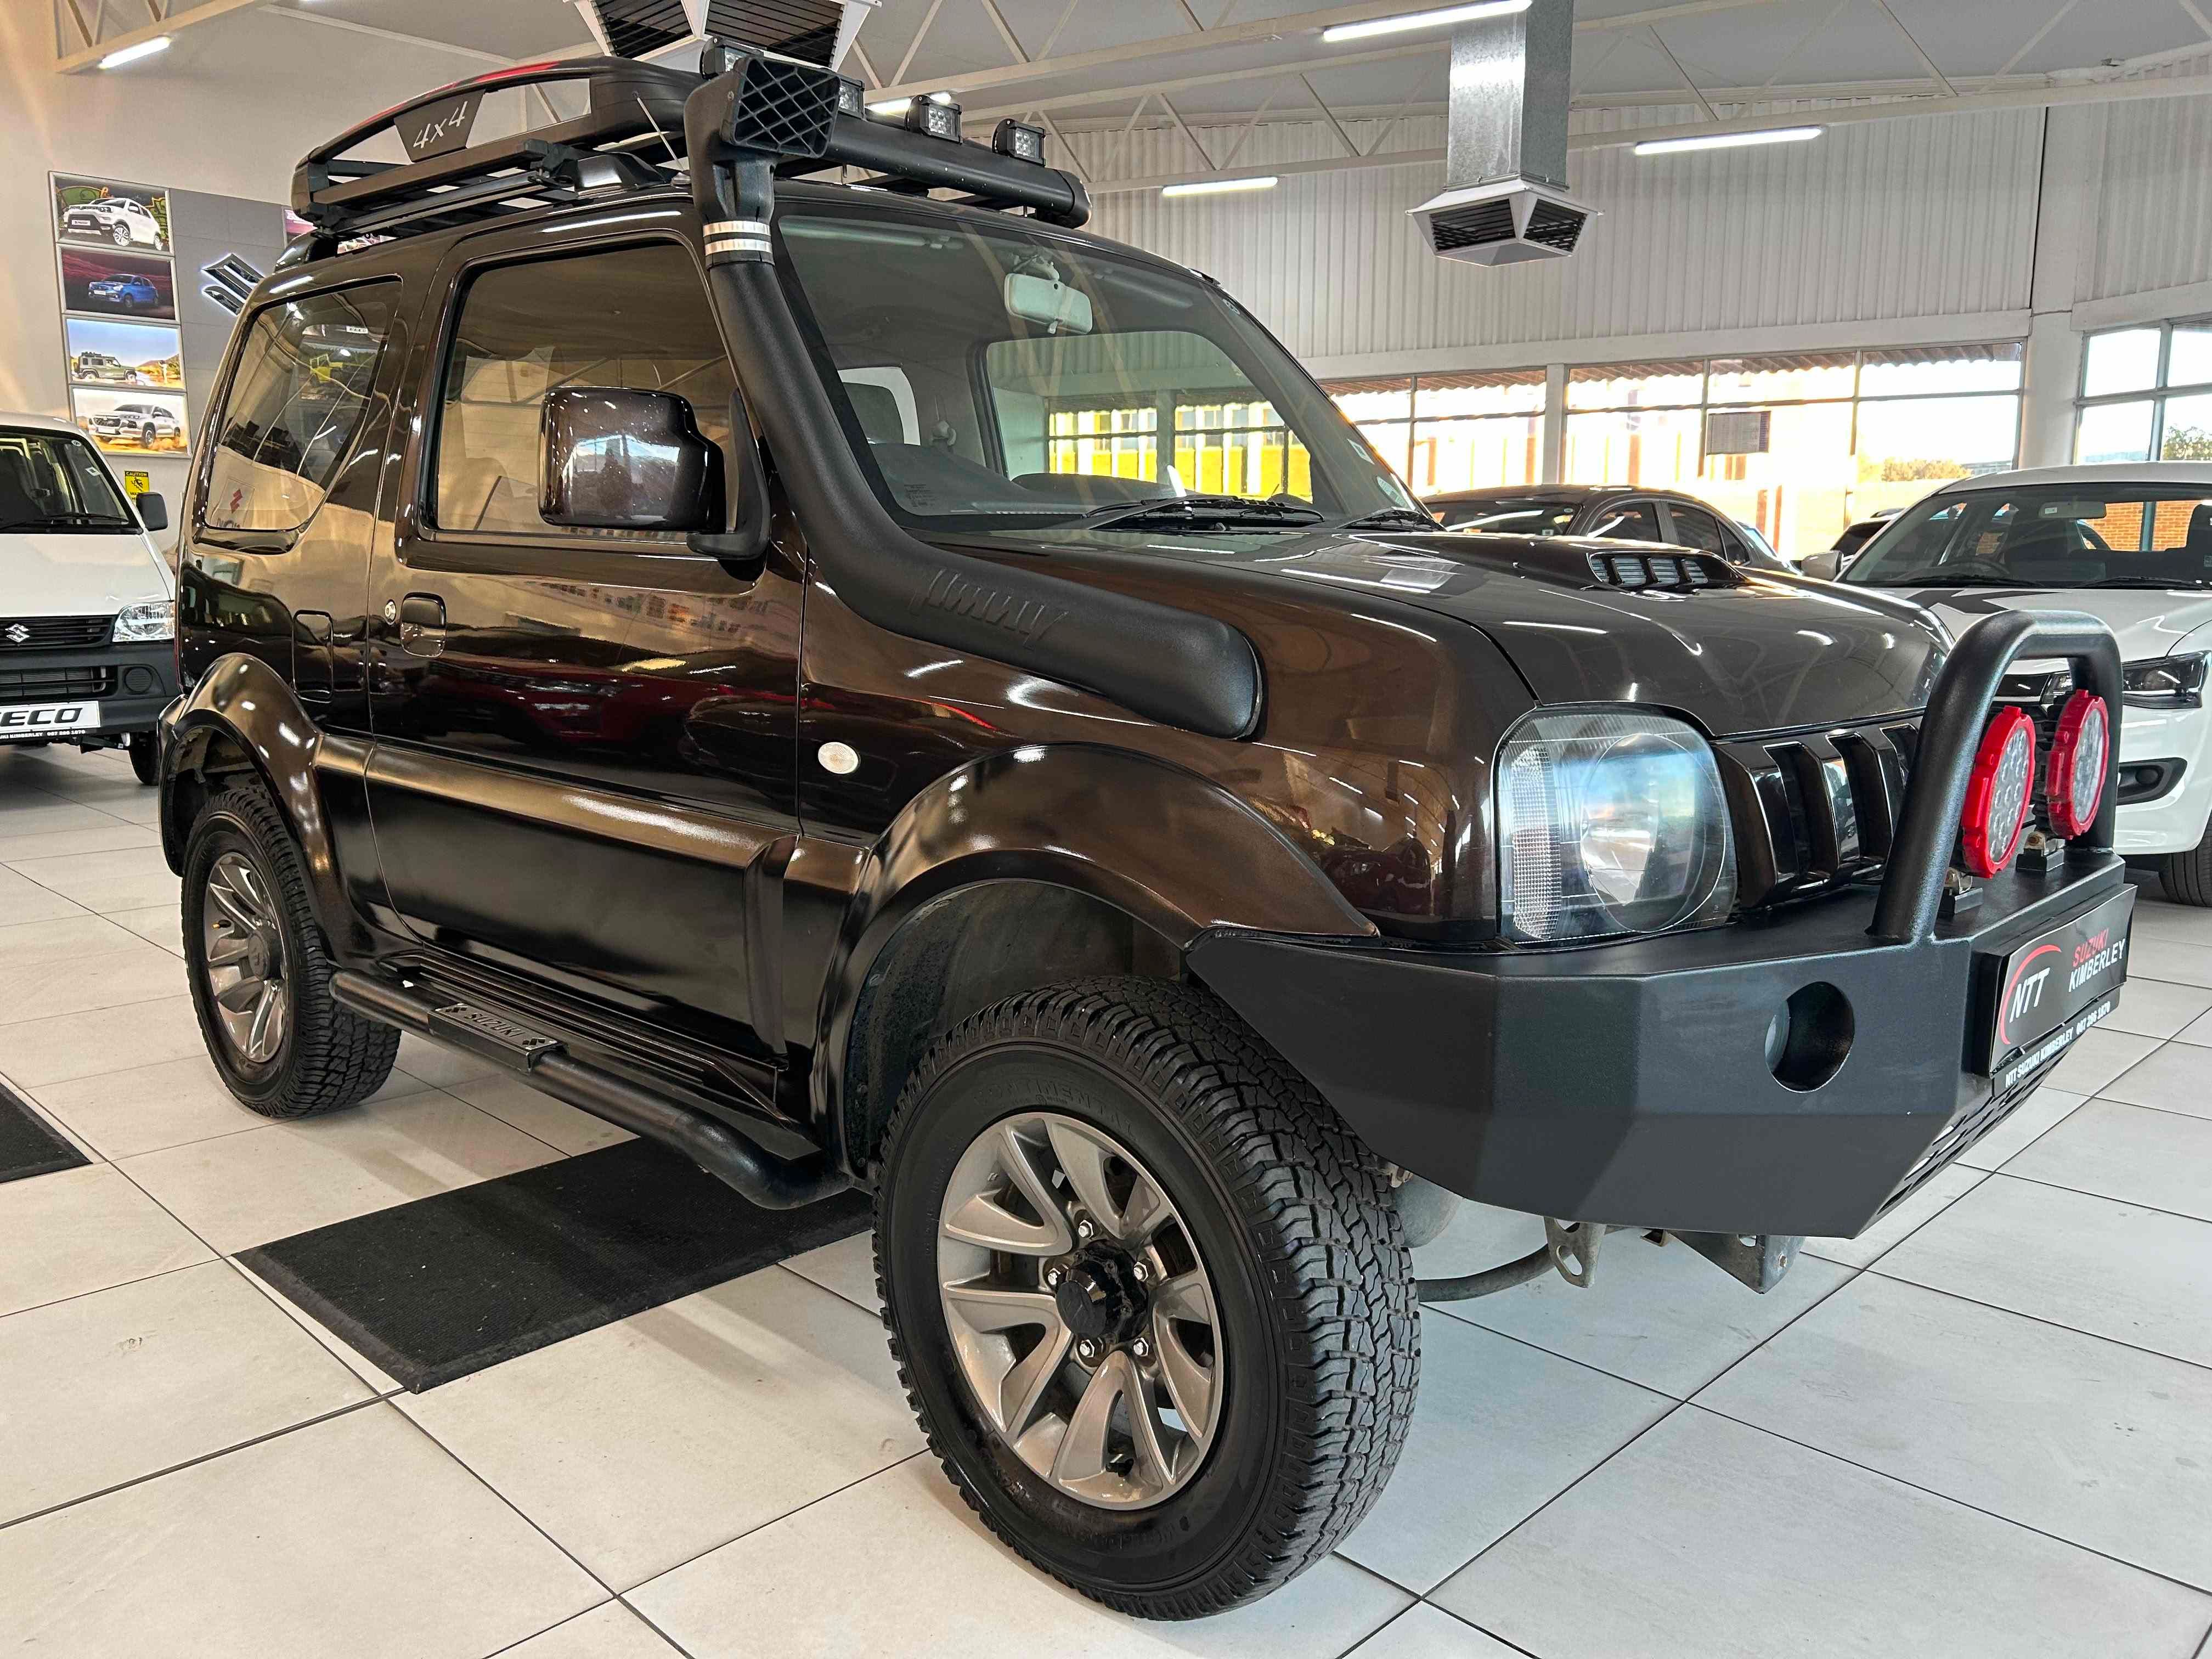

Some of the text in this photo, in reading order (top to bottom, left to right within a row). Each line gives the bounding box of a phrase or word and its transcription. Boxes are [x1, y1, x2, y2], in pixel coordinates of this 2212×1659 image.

[0, 708, 83, 727] ECO
[2068, 938, 2126, 992] KIMBERLEY
[2073, 928, 2109, 967] SUZUKI
[2009, 967, 2050, 1023] NTT
[465, 1011, 524, 1038] SUZUKI
[2005, 1068, 2017, 1088] NTT
[2017, 1051, 2040, 1078] SUZUKI
[2040, 1027, 2074, 1060] KIMBERLEY
